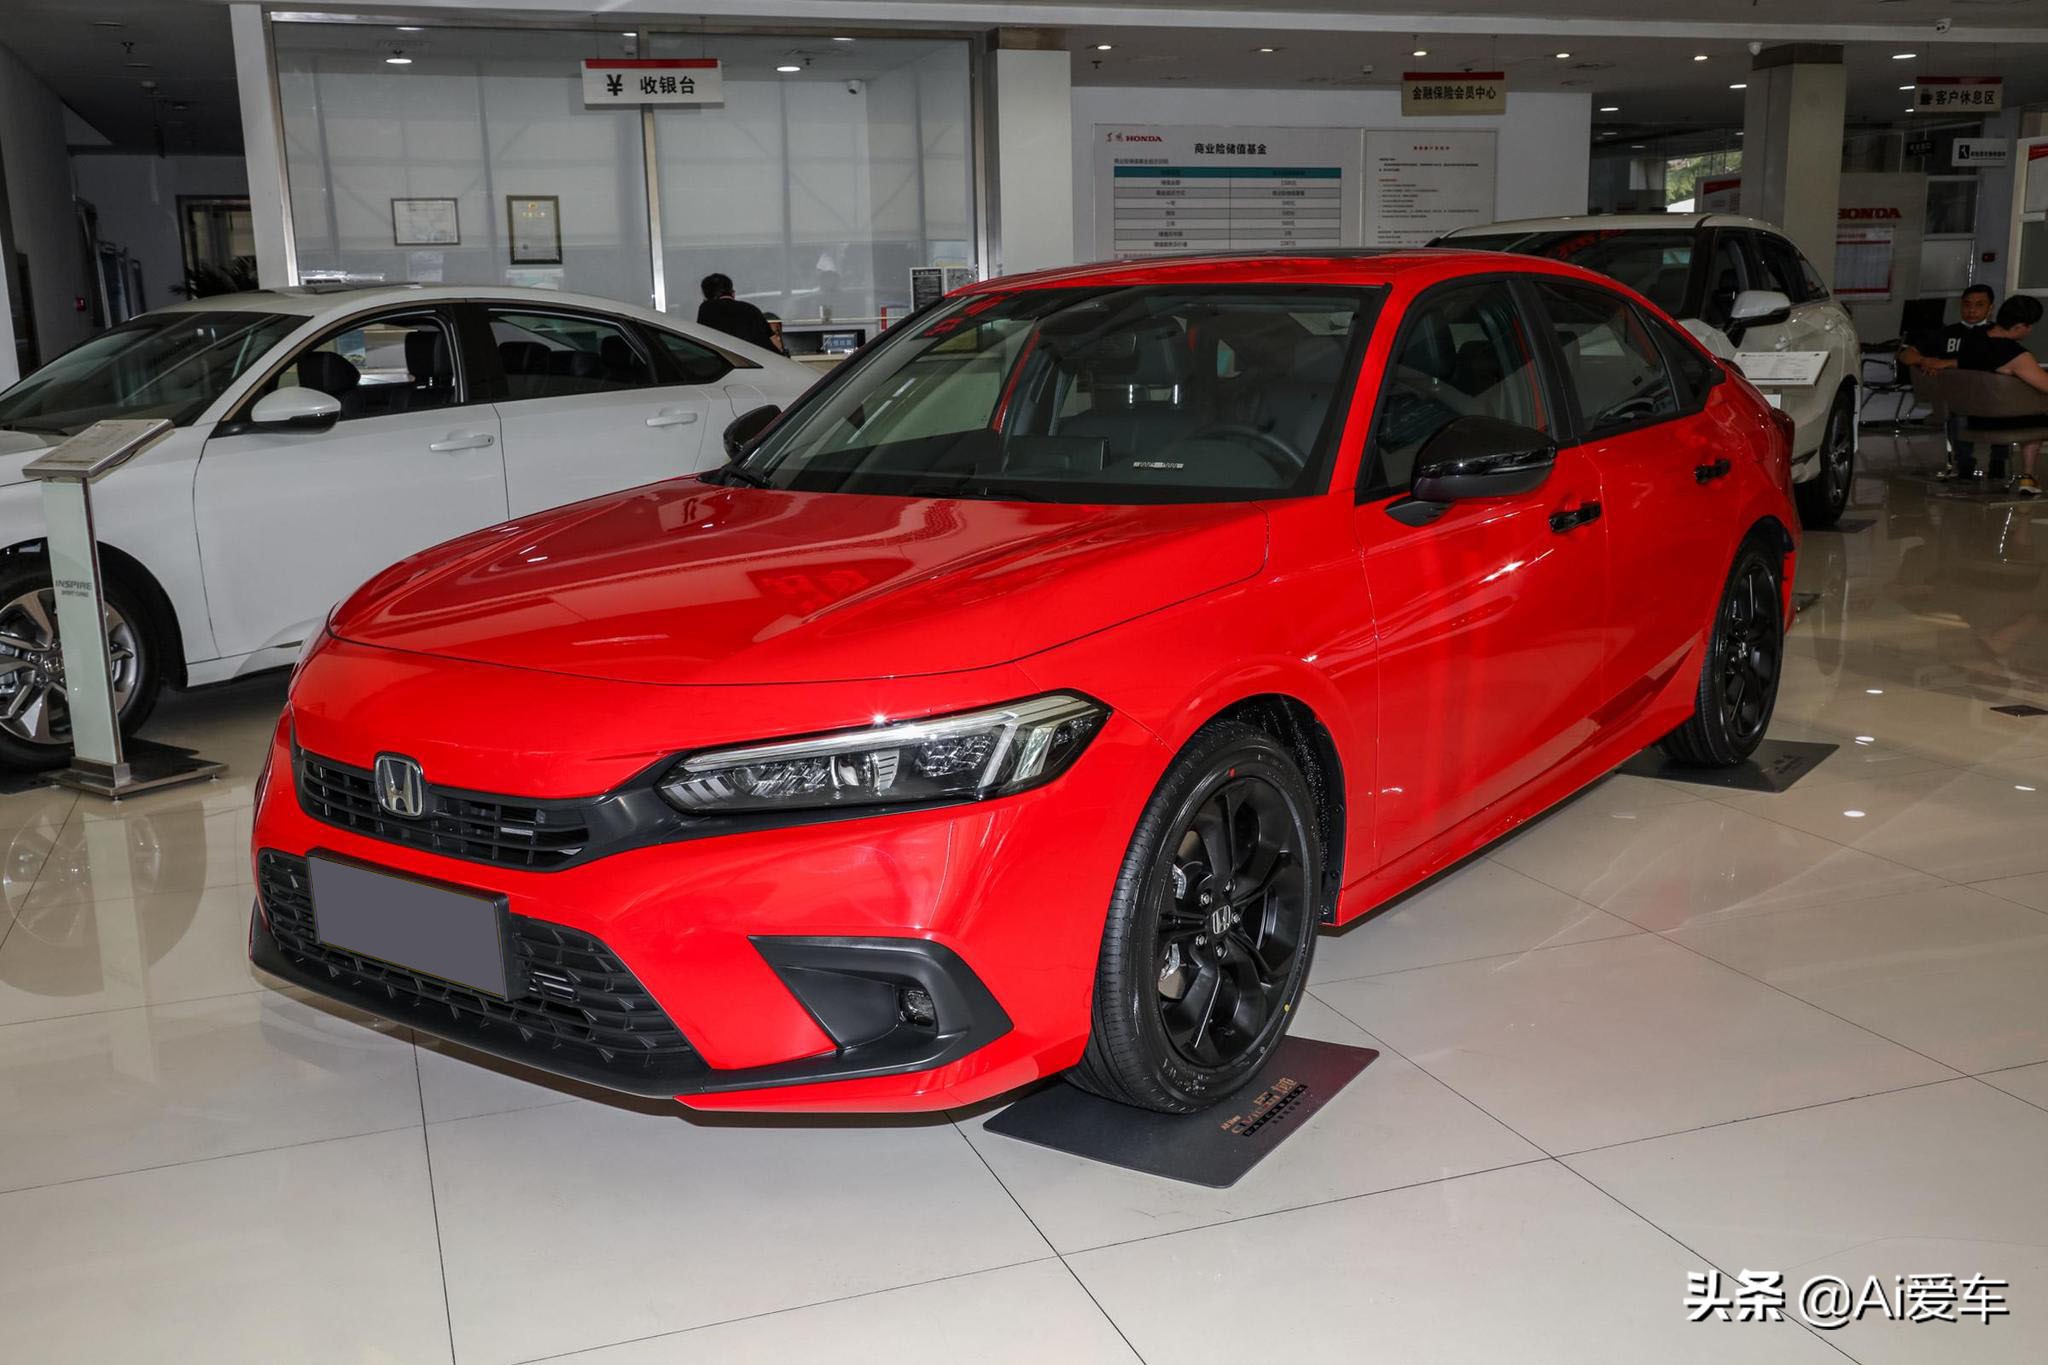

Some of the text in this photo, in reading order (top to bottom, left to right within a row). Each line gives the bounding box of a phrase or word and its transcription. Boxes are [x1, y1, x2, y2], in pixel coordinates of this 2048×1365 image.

[640, 76, 695, 95] 收银台
[1412, 85, 1496, 100] 金融保险会员中心
[1935, 90, 1996, 105] 客户休息区
[1194, 142, 1267, 155] 商业险储值基金
[55, 579, 92, 590] INSPIRE
